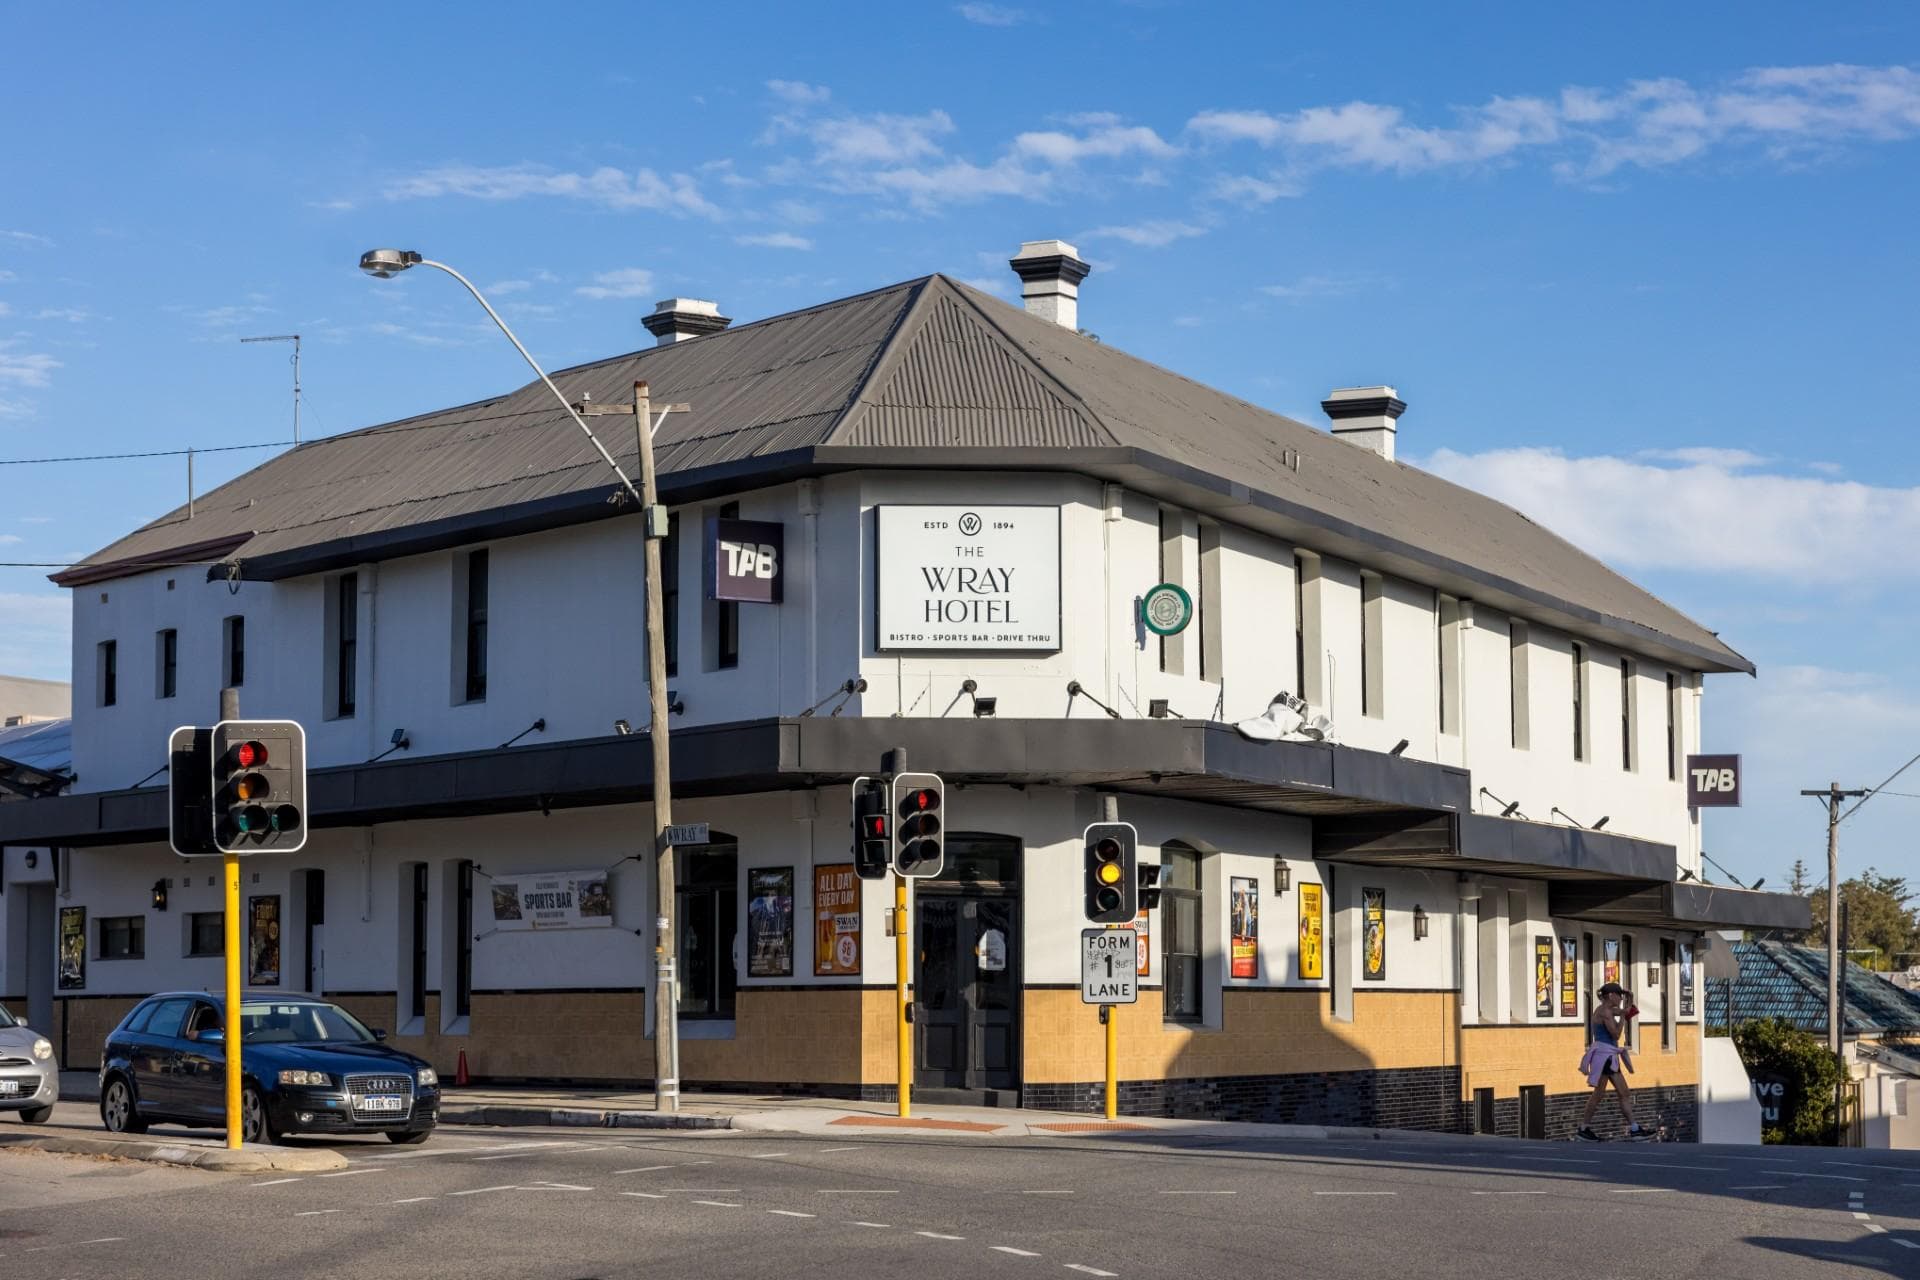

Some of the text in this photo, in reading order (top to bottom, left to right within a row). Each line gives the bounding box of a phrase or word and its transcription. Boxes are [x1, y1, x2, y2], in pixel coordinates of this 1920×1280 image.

[924, 521, 948, 529] ESTD
[720, 541, 778, 579] TAB
[954, 546, 984, 557] THE
[920, 567, 1015, 594] WRAY
[924, 599, 1019, 623] HOTEL
[1691, 768, 1735, 792] TAB
[673, 826, 697, 841] WRAY
[820, 872, 854, 892] ALL DAY
[524, 892, 572, 910] SPORTS BAR
[819, 890, 855, 907] EVERY DAY
[836, 916, 858, 926] SWAN
[1089, 936, 1130, 949] FORM
[1104, 954, 1112, 978] 1
[1089, 984, 1130, 997] LANE
[1751, 1078, 1784, 1096] ive
